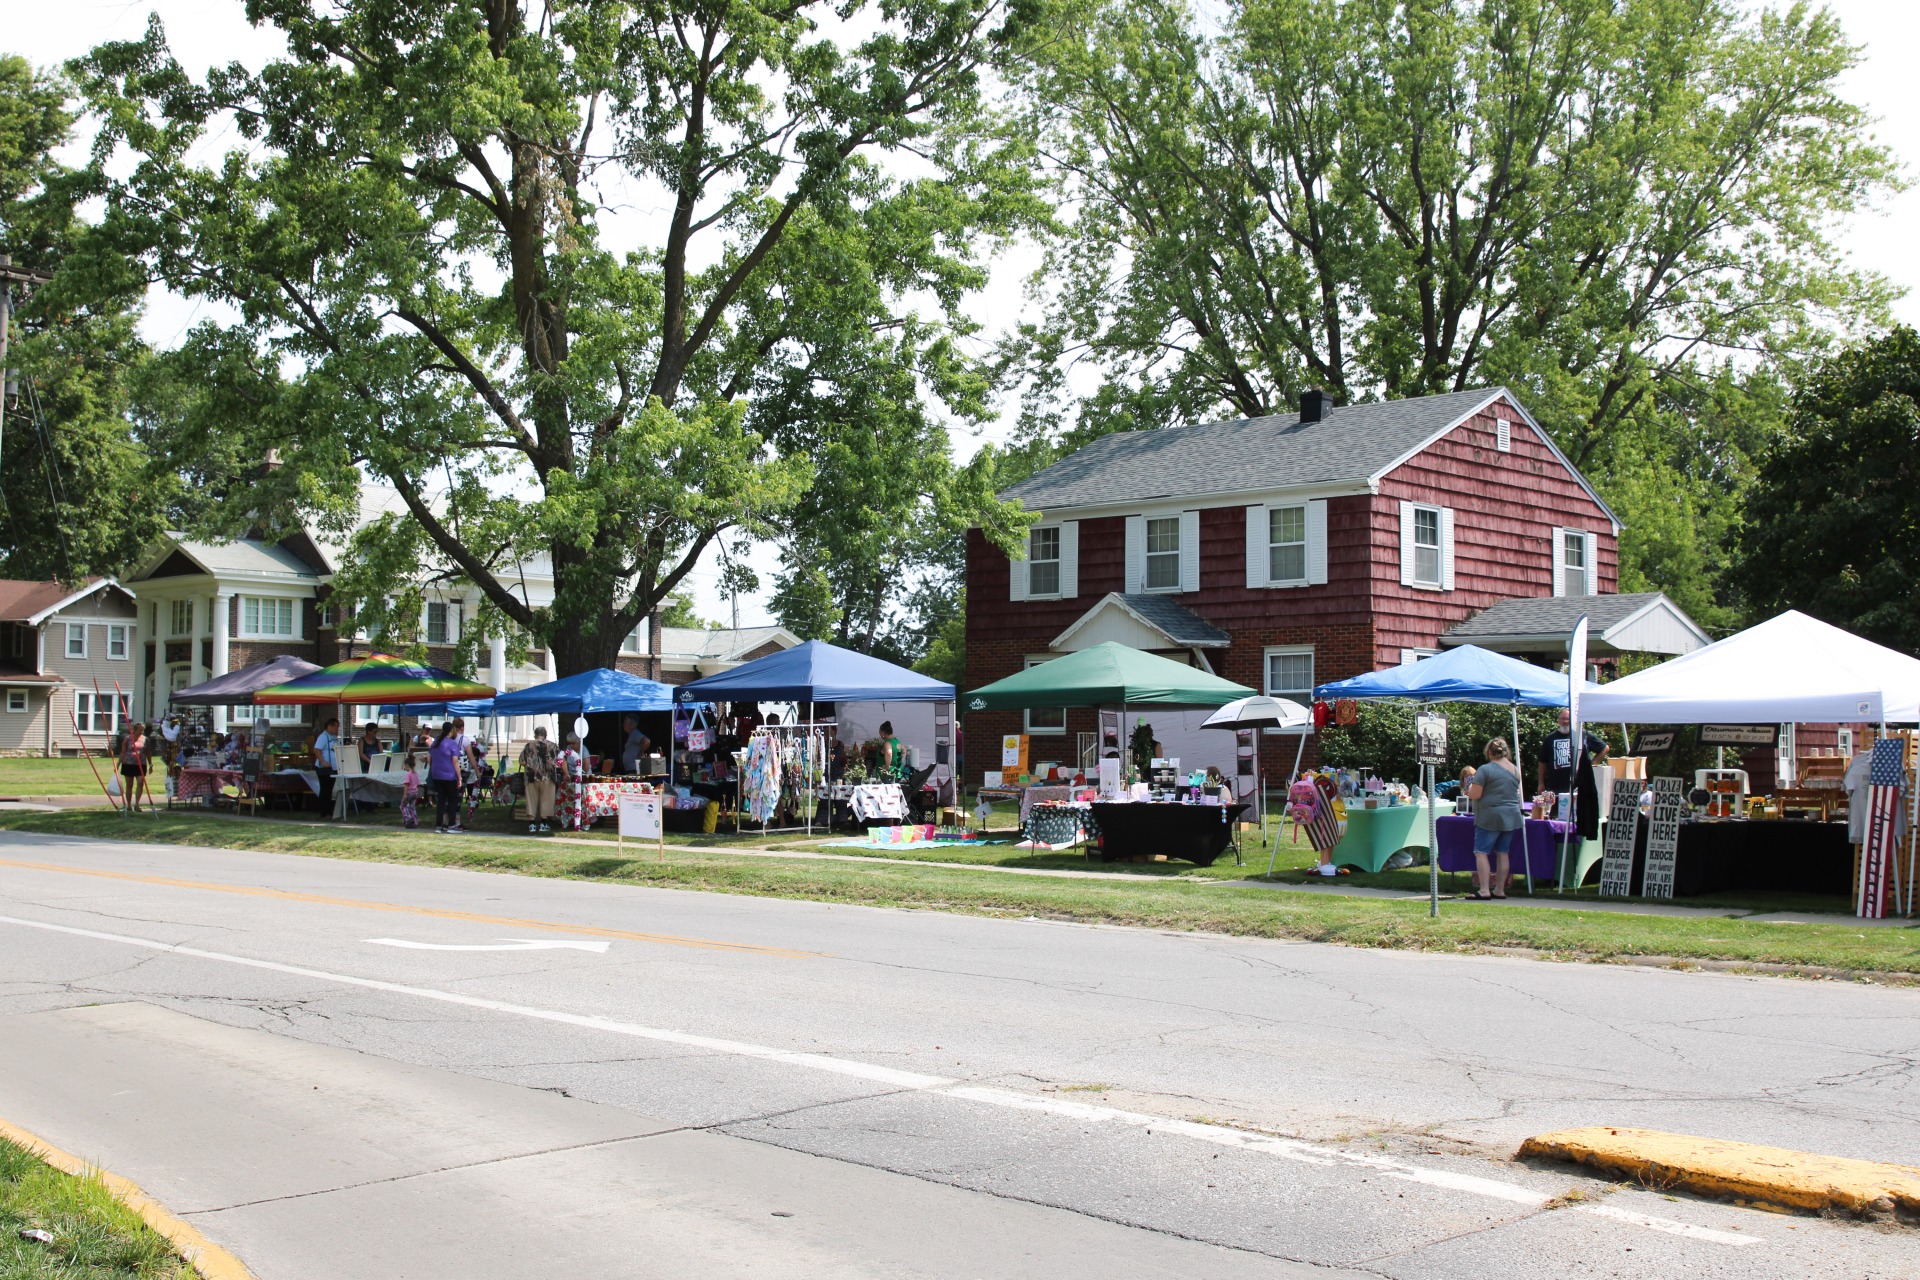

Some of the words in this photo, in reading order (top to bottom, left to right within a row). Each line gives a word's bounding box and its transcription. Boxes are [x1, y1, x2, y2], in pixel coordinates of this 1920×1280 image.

[1557, 741, 1570, 749] GOO
[1611, 807, 1635, 822] LIVE
[1654, 807, 1676, 822] LIVE
[1609, 824, 1633, 840] HERE
[1652, 824, 1676, 841] HERE
[1606, 849, 1630, 859] KNOCK
[1649, 850, 1674, 861] KNOCK
[1602, 881, 1628, 896] HERE!
[1646, 883, 1671, 898] HERE!
